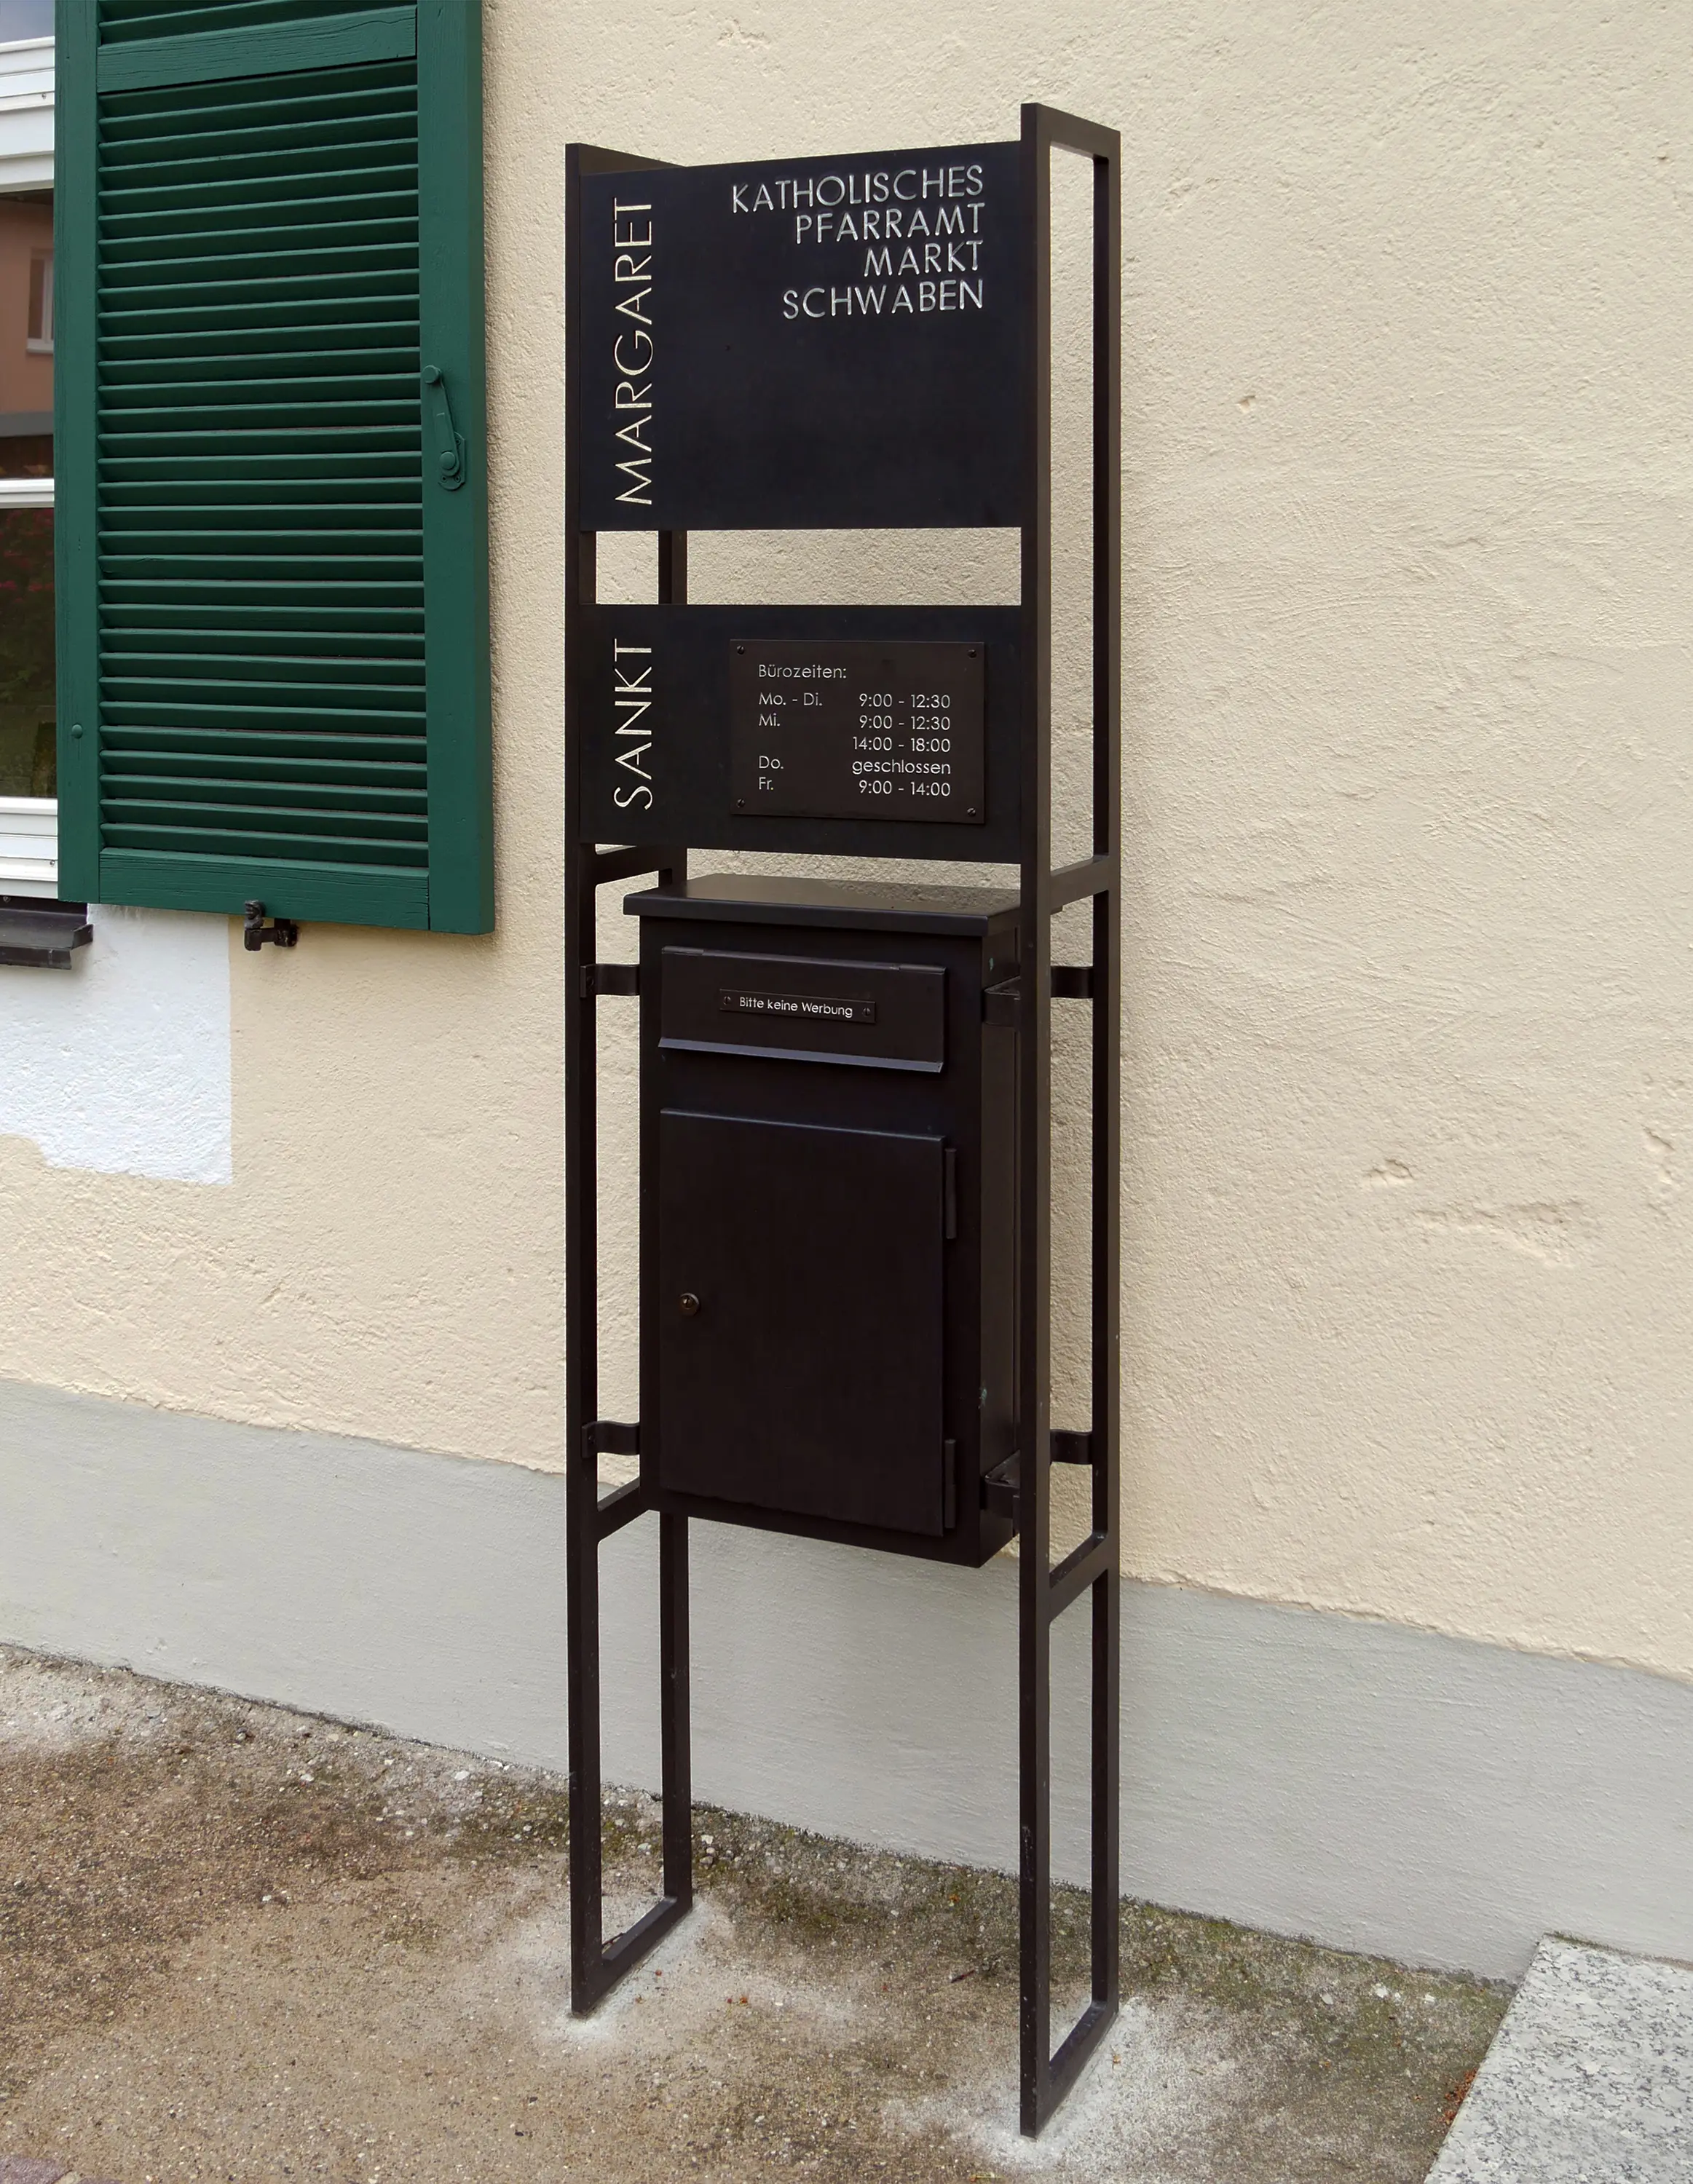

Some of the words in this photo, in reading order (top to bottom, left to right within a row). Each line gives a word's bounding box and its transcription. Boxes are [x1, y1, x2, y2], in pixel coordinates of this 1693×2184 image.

[733, 165, 983, 213] KATHOLISCHES
[797, 202, 985, 245] PFARRAMT
[864, 240, 984, 277] MARKT
[783, 280, 983, 319] SCHWABEN
[614, 197, 653, 505] MARGARET
[759, 664, 846, 678] Bürozeiten:
[759, 693, 786, 705] Mo.
[803, 692, 823, 706] Di.
[859, 693, 892, 708] 9:00
[911, 694, 950, 708] 12:30
[613, 638, 653, 810] SANKT
[759, 713, 781, 727] Mi.
[859, 715, 893, 729] 9:00
[910, 716, 950, 731] 12:30
[853, 736, 892, 751] 14:00
[910, 737, 950, 753] 18:00
[759, 756, 784, 769] Do.
[852, 759, 951, 775] geschlossen
[759, 777, 774, 791] Fr.
[859, 780, 892, 794] 9:00
[910, 781, 951, 796] 14:00
[739, 997, 765, 1008] Bitte
[767, 999, 798, 1011] keine
[801, 1002, 853, 1018] Werbung
